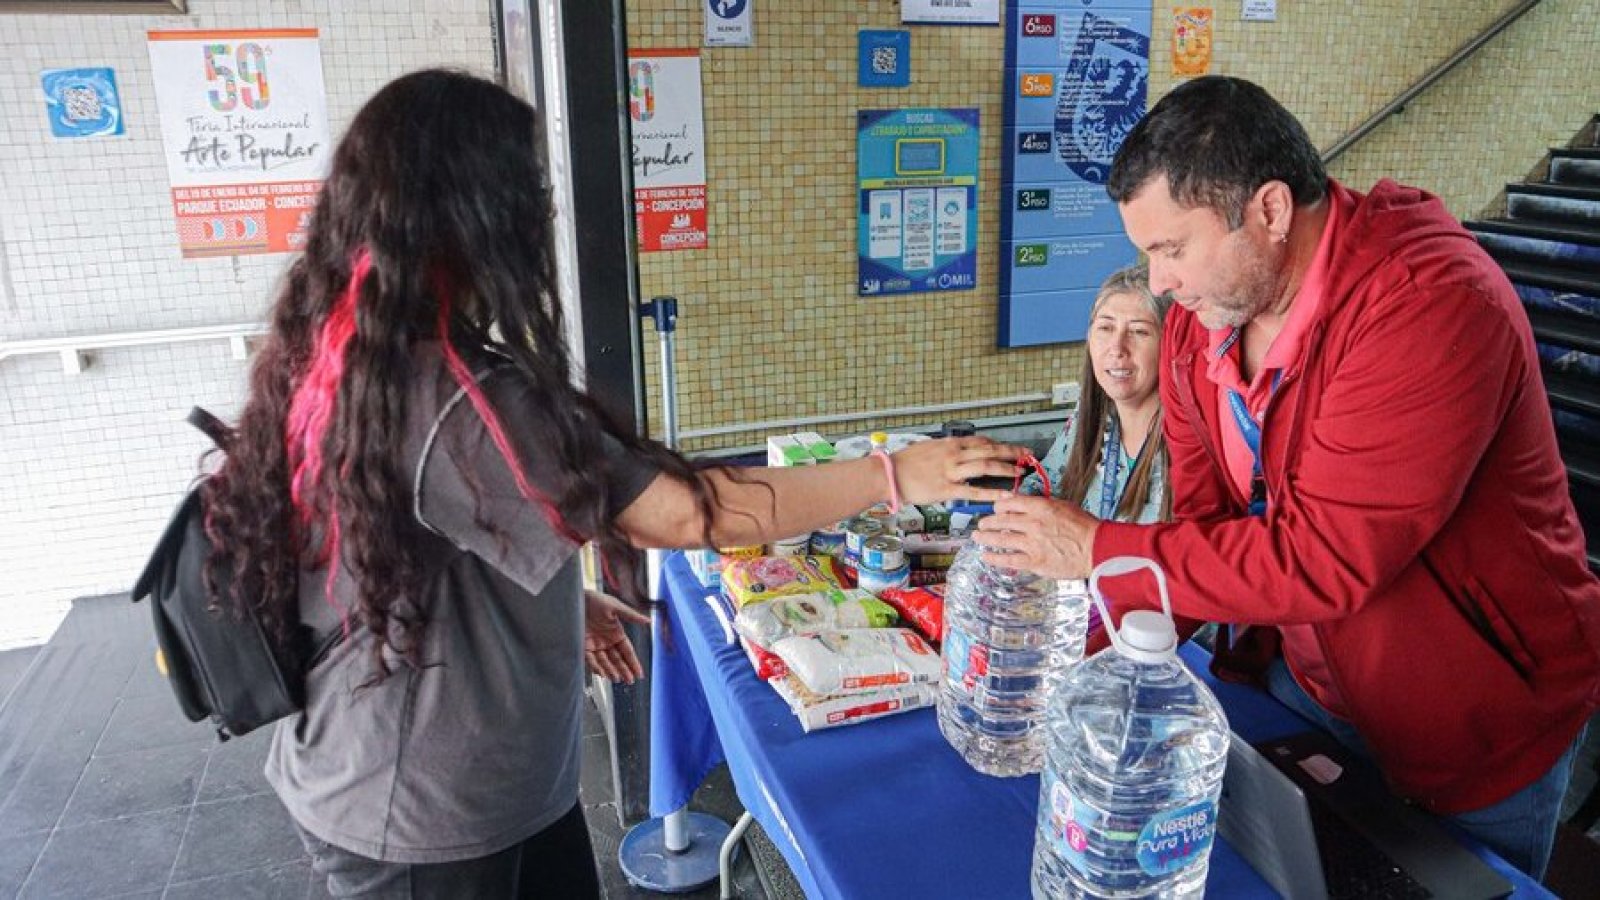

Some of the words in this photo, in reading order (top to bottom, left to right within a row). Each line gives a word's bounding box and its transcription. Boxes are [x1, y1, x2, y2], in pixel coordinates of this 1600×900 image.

[1036, 25, 1053, 34] PISO
[1034, 83, 1051, 92] PISO
[224, 113, 310, 132] Internacional
[180, 136, 231, 167] Arte
[234, 131, 319, 170] Popular
[1033, 141, 1048, 150] PISO
[632, 142, 694, 176] opular
[175, 189, 190, 200] DEL
[201, 187, 212, 198] DE
[213, 186, 237, 198] ENERO
[259, 184, 269, 195] DE
[270, 182, 303, 194] FEBRERO
[649, 187, 678, 198] FEBRERO
[177, 200, 219, 215] PARQUE
[220, 197, 266, 212] ECUADOR
[1031, 199, 1048, 208] PISO
[1029, 253, 1045, 262] PISO
[1153, 811, 1208, 837] Nestlé
[1139, 836, 1178, 853] Pura
